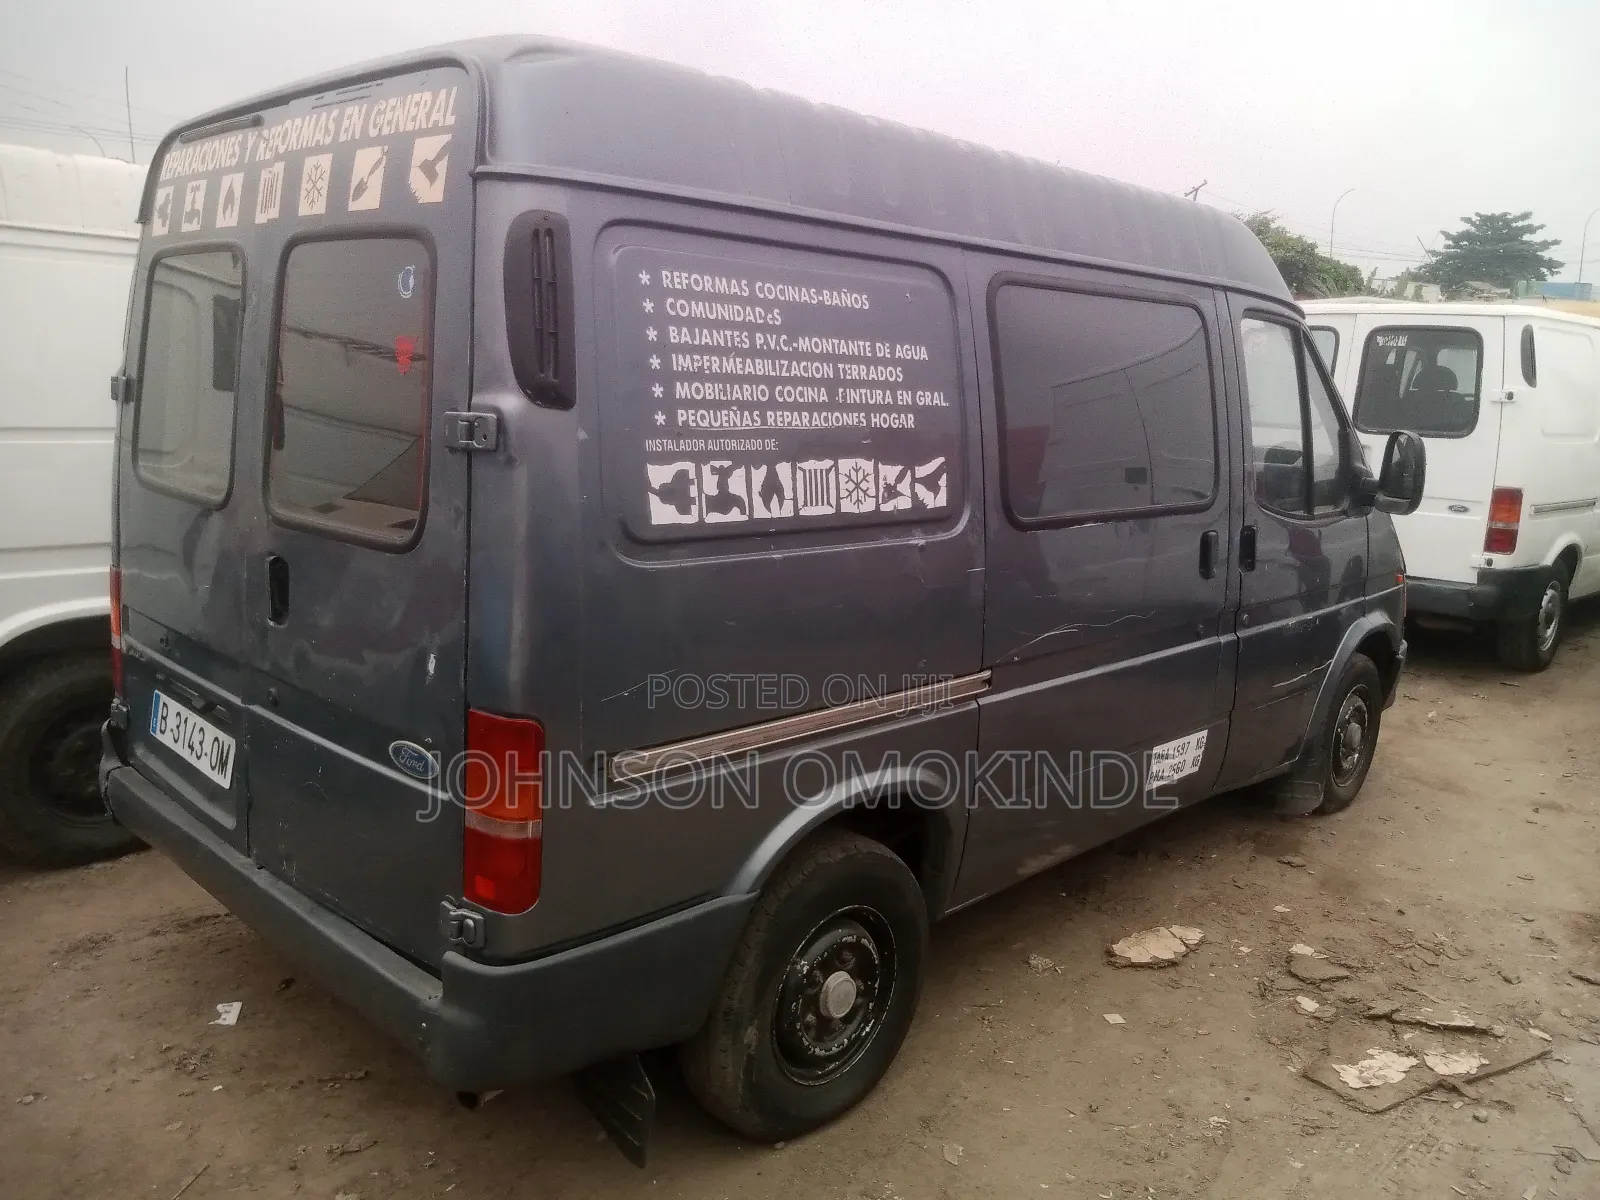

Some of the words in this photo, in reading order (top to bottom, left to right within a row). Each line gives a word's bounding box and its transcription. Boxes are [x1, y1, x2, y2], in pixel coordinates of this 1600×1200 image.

[159, 134, 242, 181] REPARACIONES
[245, 131, 258, 163] Y
[256, 109, 339, 161] REFORMAS
[339, 104, 367, 142] EN
[369, 87, 457, 138] GENERAL
[662, 270, 749, 297] REFORMAS
[755, 281, 869, 310] COCINAS-BAÑOS
[669, 326, 750, 349] BAJANTES
[756, 333, 872, 357] P.V.C.-MONTANTE
[876, 342, 891, 359] DE
[895, 344, 929, 360] AGUA
[838, 363, 903, 382] TERRADOS
[675, 382, 770, 402] MOBILIARIO
[775, 385, 829, 403] COCINA
[897, 390, 912, 406] EN
[916, 391, 949, 407] GRAL.
[677, 406, 762, 428] PEQUEÑAS
[766, 410, 867, 428] REPARACIONES
[871, 412, 915, 429] HOGAR
[645, 439, 705, 452] INSTALADOR
[708, 439, 763, 451] AUTORIZADO
[765, 439, 779, 451] DE:
[399, 746, 425, 772] Ford
[1172, 741, 1191, 759] 1597
